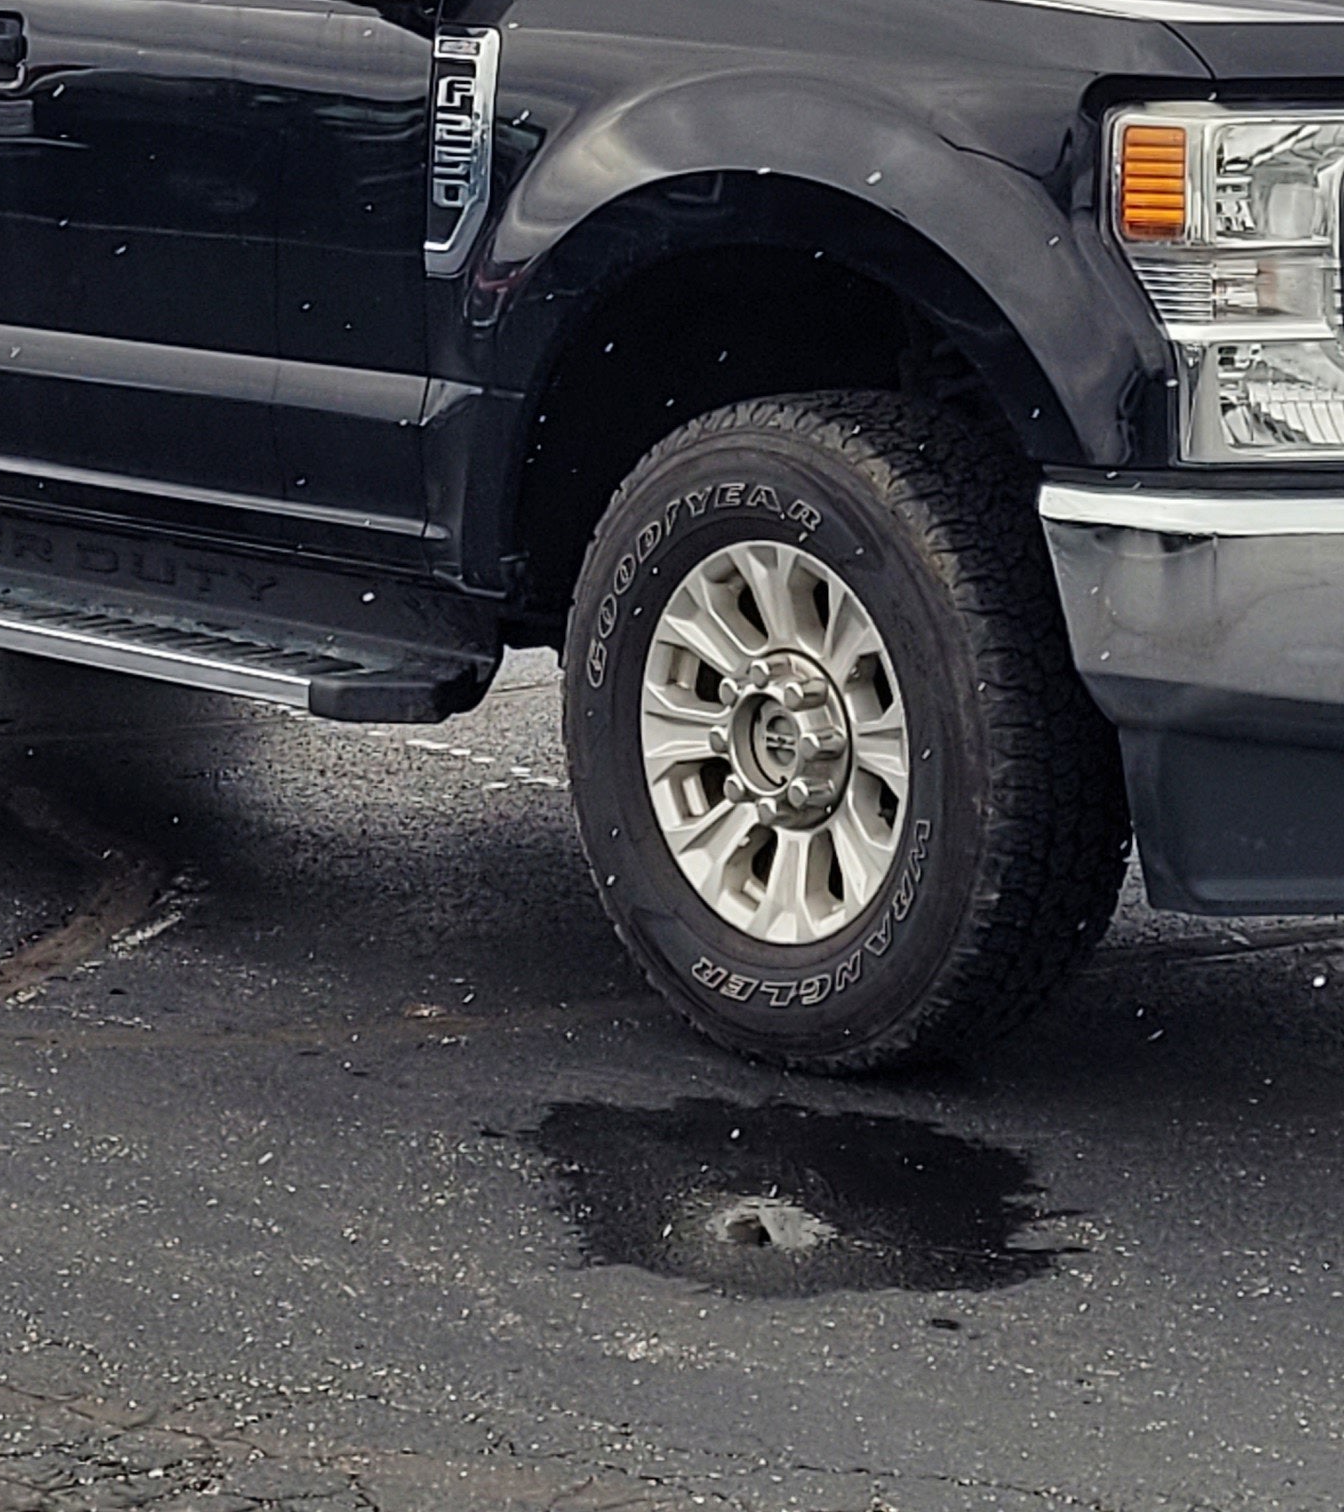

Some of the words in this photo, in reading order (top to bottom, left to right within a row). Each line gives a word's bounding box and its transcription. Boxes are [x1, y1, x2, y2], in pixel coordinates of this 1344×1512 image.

[75, 541, 277, 601] DUTY
[586, 482, 823, 688] GOODYEAR
[692, 819, 932, 1006] WRANGLER
